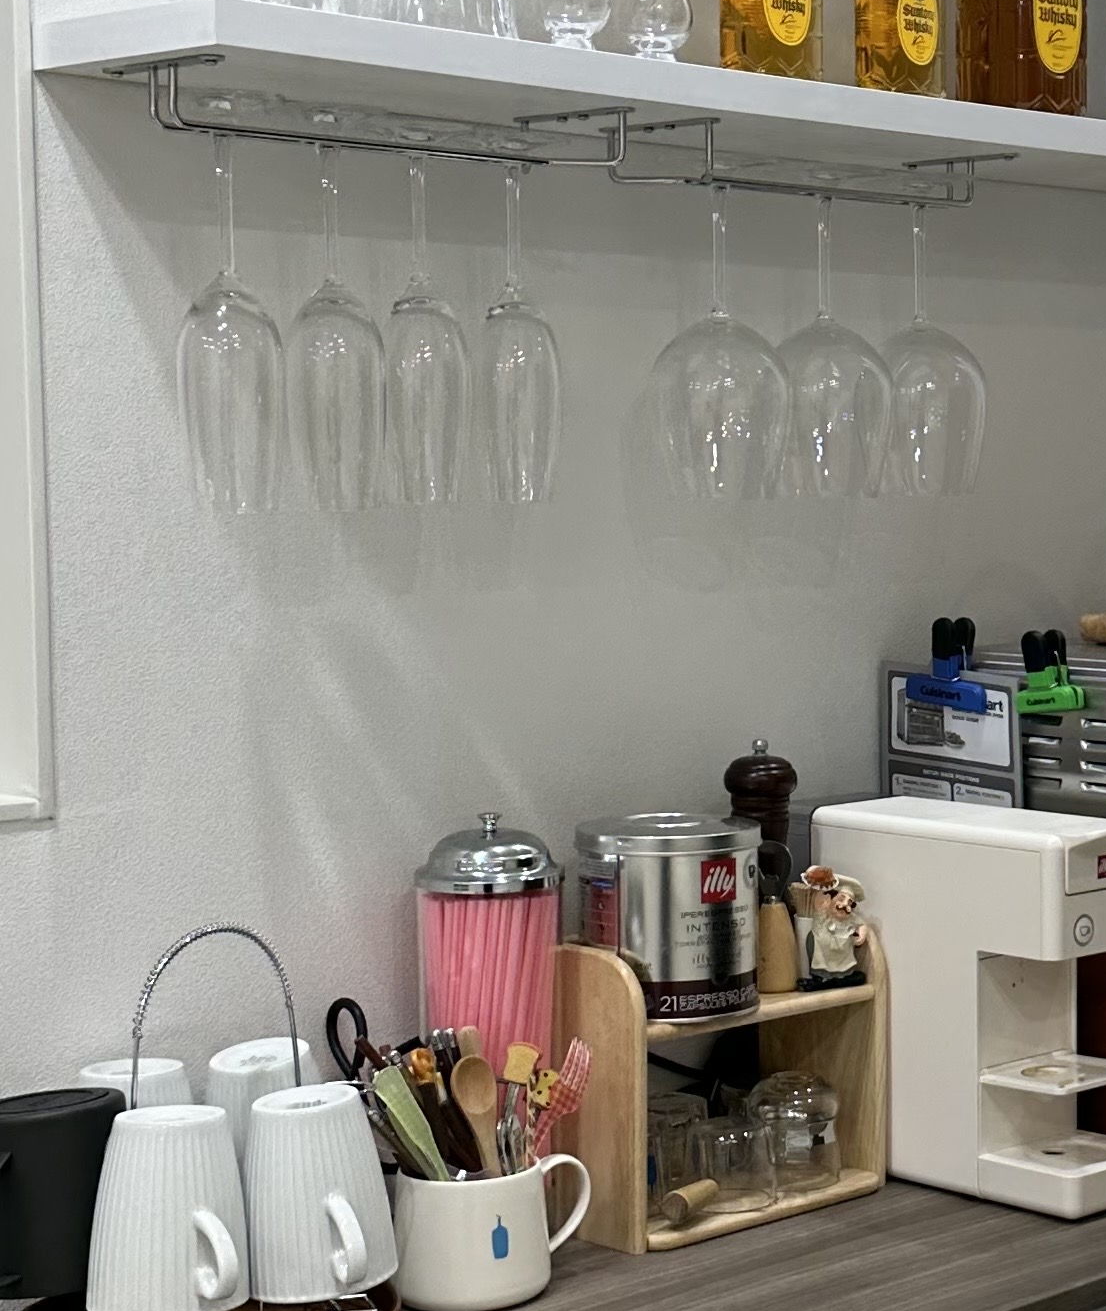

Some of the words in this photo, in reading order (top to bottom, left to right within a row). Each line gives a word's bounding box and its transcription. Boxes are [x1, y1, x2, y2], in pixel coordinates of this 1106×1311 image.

[902, 3, 935, 22] Suntory
[1038, 6, 1077, 28] Whisky
[903, 18, 934, 37] Whisky
[920, 685, 961, 701] Cuisinart
[1026, 697, 1056, 706] Cuisinart
[703, 866, 735, 898] illy
[687, 918, 746, 933] INTENSO
[660, 996, 678, 1012] 21
[680, 989, 739, 1004] ESPRESSO
